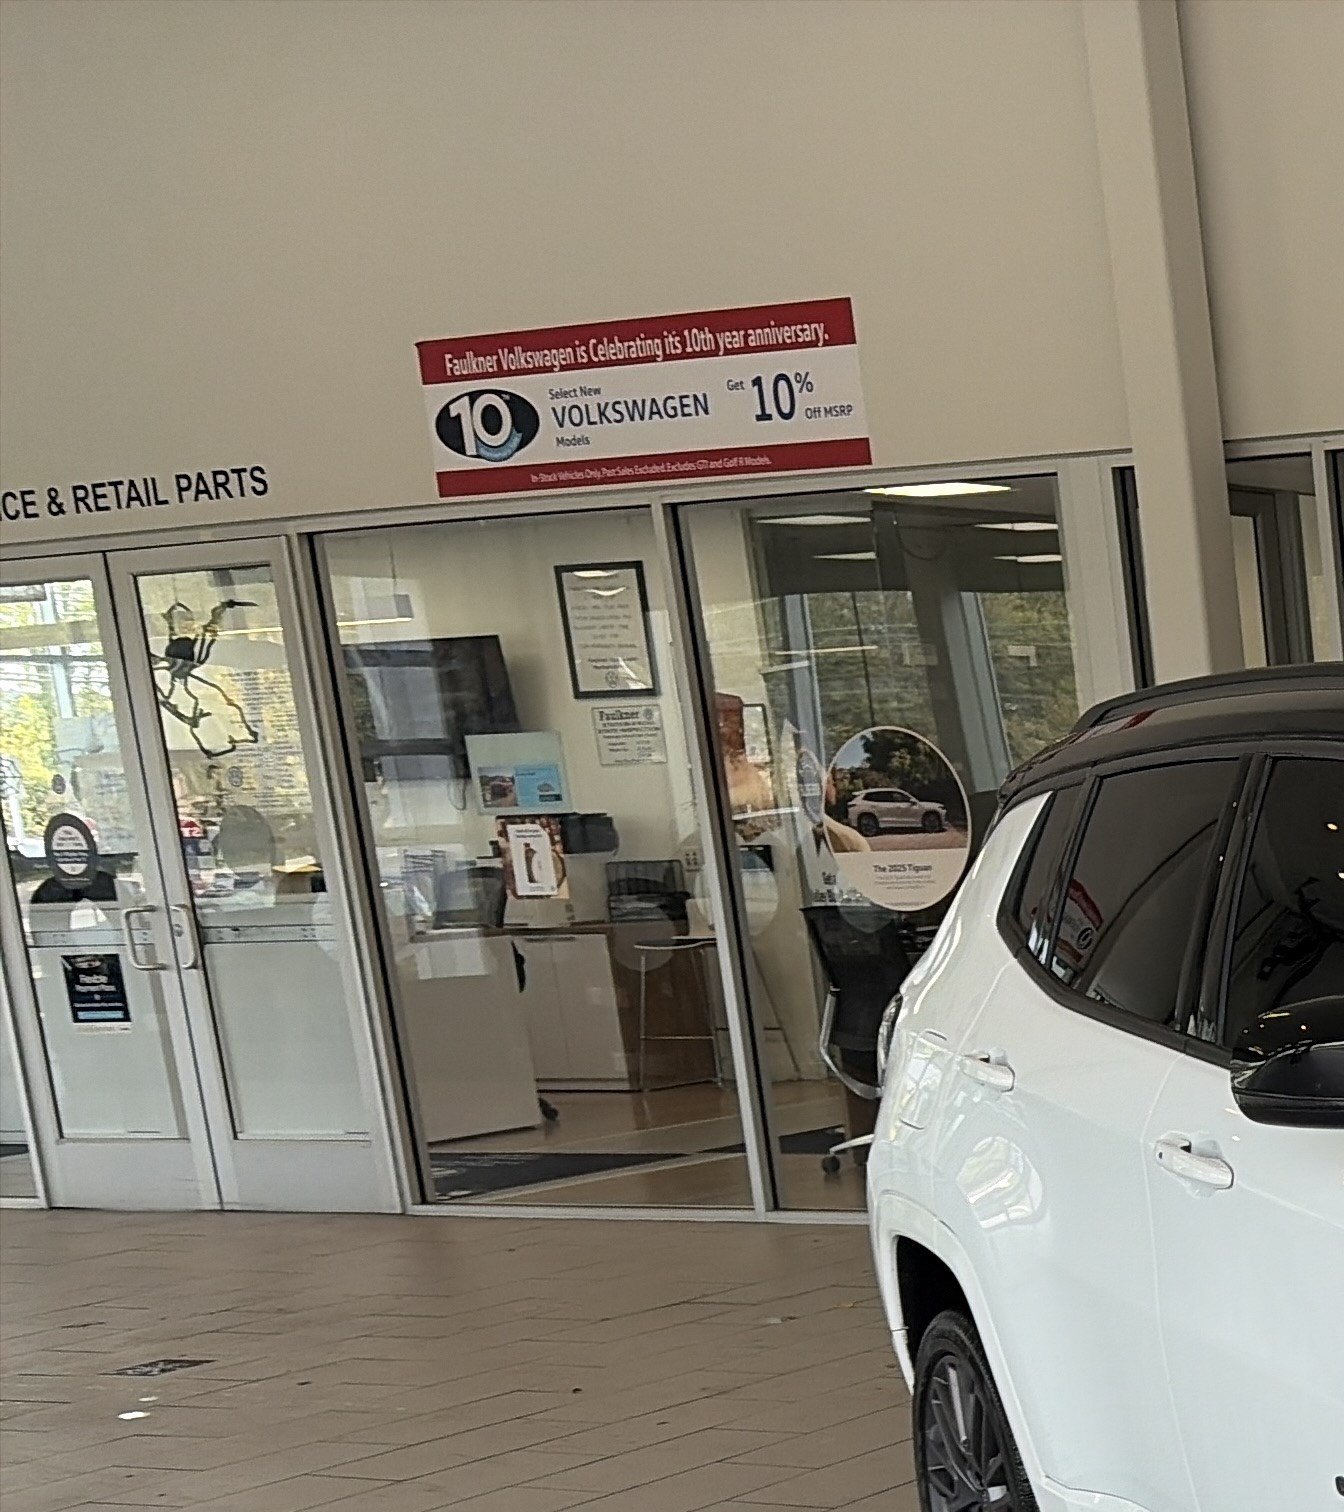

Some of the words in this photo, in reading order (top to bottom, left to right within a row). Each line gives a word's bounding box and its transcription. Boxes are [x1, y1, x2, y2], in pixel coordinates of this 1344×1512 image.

[444, 350, 499, 376] Faulkner
[498, 346, 575, 372] Volkswagen
[575, 340, 588, 363] is
[589, 333, 663, 362] Celebrating
[683, 327, 715, 353] 10th
[716, 329, 745, 356] year
[748, 320, 829, 347] anniversary.
[549, 387, 577, 400] Select
[579, 385, 601, 397] New
[726, 379, 745, 391] Get
[551, 392, 710, 429] VOLKSWAGEN
[805, 406, 821, 419] Off
[823, 404, 853, 418] MSRP
[556, 435, 590, 448] Models
[0, 490, 39, 521] CE
[47, 487, 66, 517] &
[72, 476, 169, 514] RETAIL
[175, 465, 268, 503] PARTS
